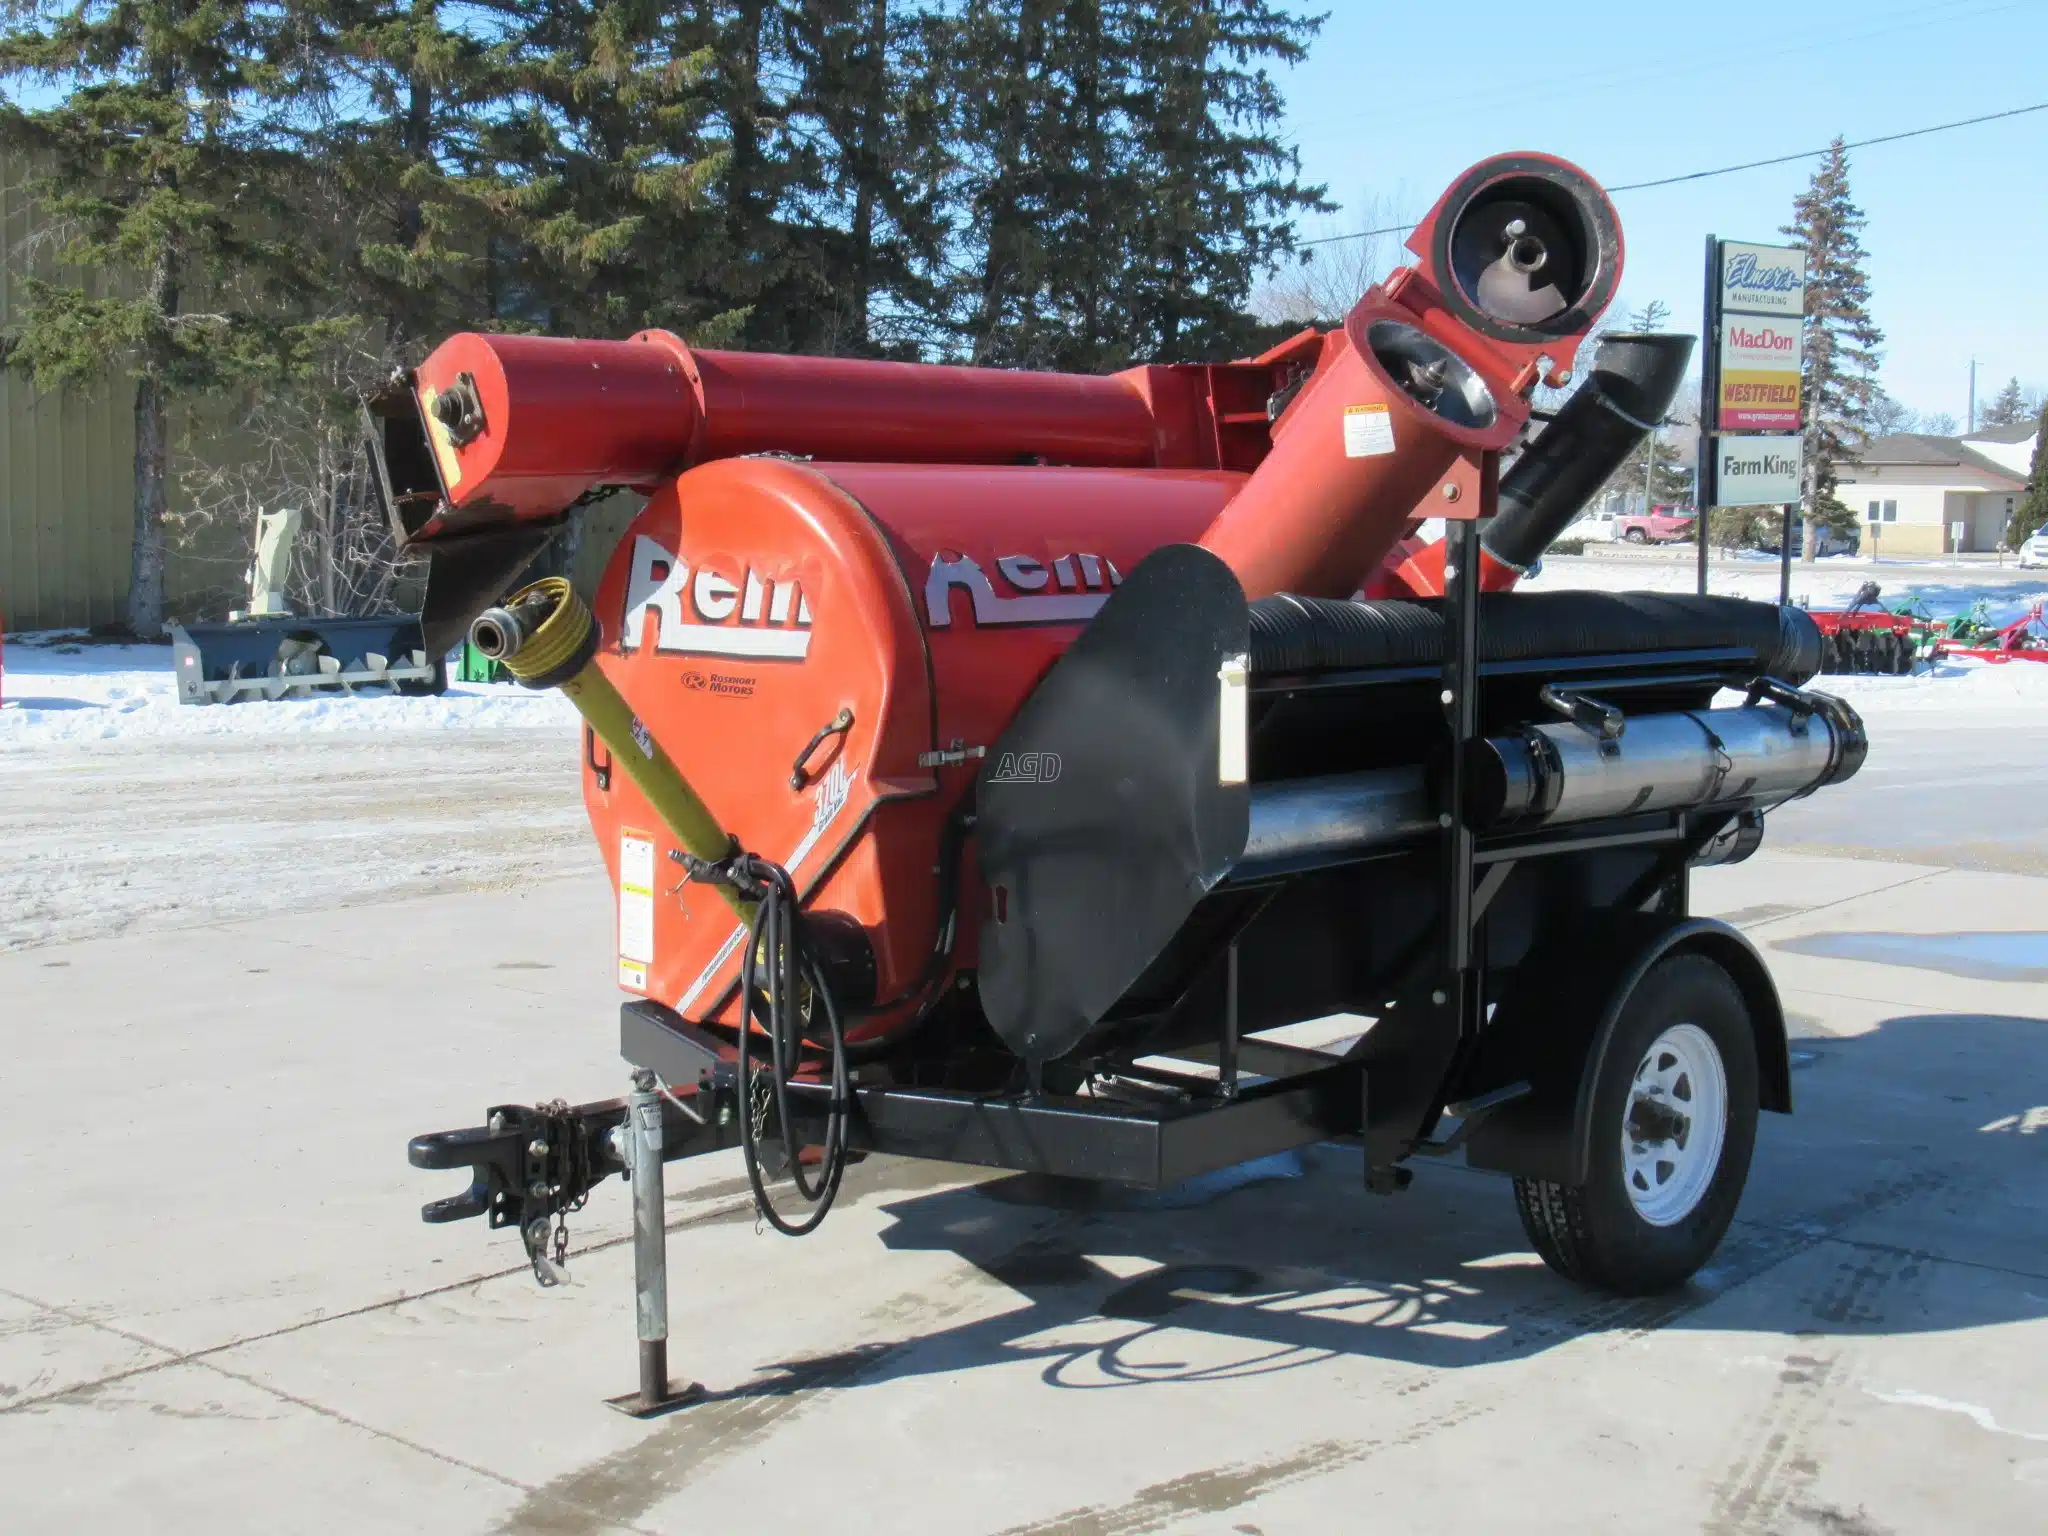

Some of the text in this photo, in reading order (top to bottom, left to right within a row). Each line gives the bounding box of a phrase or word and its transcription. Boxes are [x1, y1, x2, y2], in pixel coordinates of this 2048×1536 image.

[1725, 252, 1803, 292] Elmer's
[1732, 292, 1787, 305] MANUFACTURING
[1729, 326, 1793, 350] MacDon
[1724, 383, 1796, 402] WESTFIELD
[1723, 454, 1797, 480] Farm King
[624, 534, 813, 660] Rem
[709, 682, 754, 695] MOTORS
